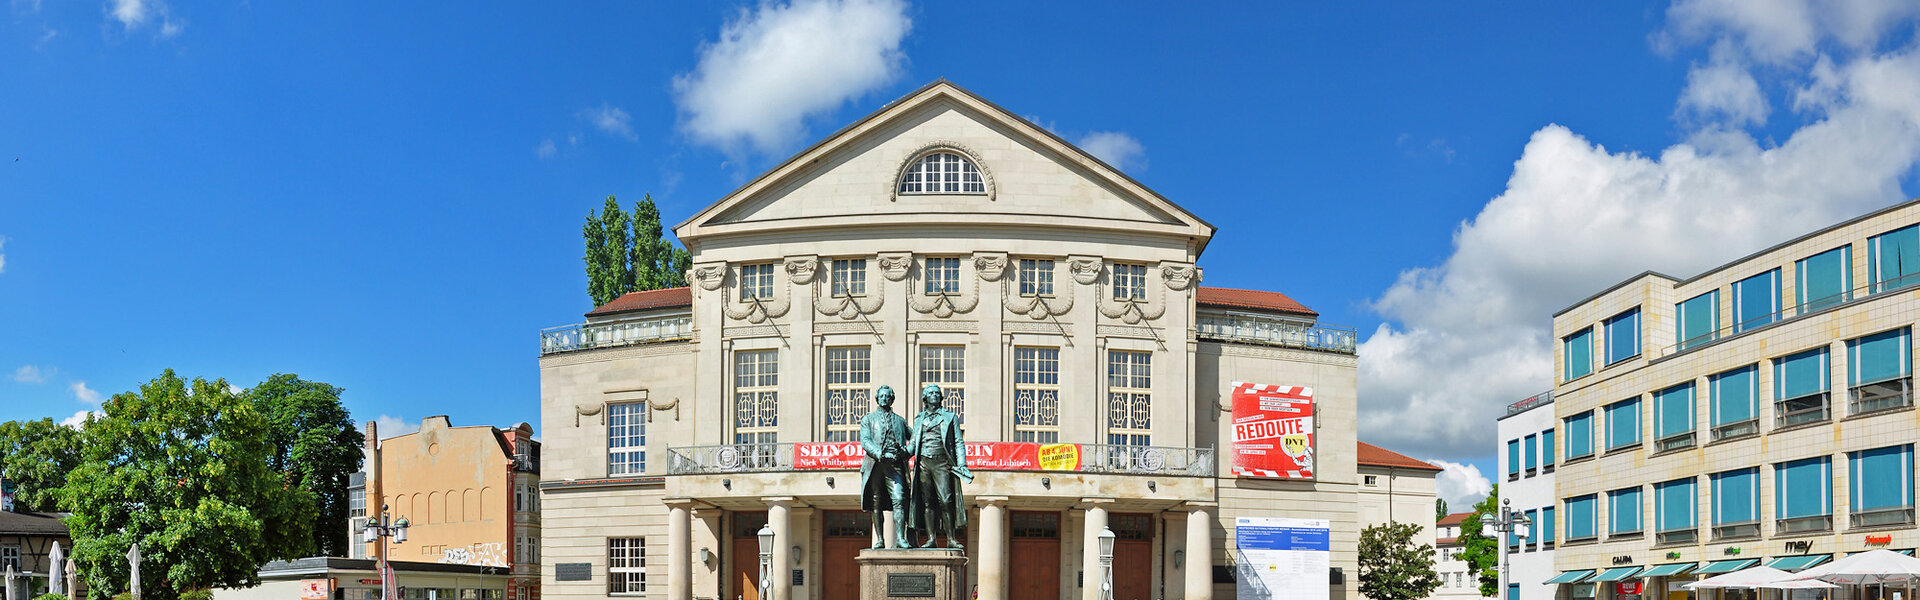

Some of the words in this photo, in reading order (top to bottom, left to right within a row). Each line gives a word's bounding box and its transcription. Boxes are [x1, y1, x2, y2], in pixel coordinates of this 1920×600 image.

[1236, 419, 1303, 440] REDOUTE
[1285, 438, 1305, 446] DNT
[800, 444, 841, 457] SEIN
[1058, 446, 1073, 454] JUNI
[800, 458, 816, 466] Nick
[819, 458, 846, 468] Whitby
[976, 458, 997, 466] Ernst
[999, 458, 1032, 467] Lubitsch
[1864, 534, 1892, 546] Triumph
[1785, 540, 1813, 554] mey
